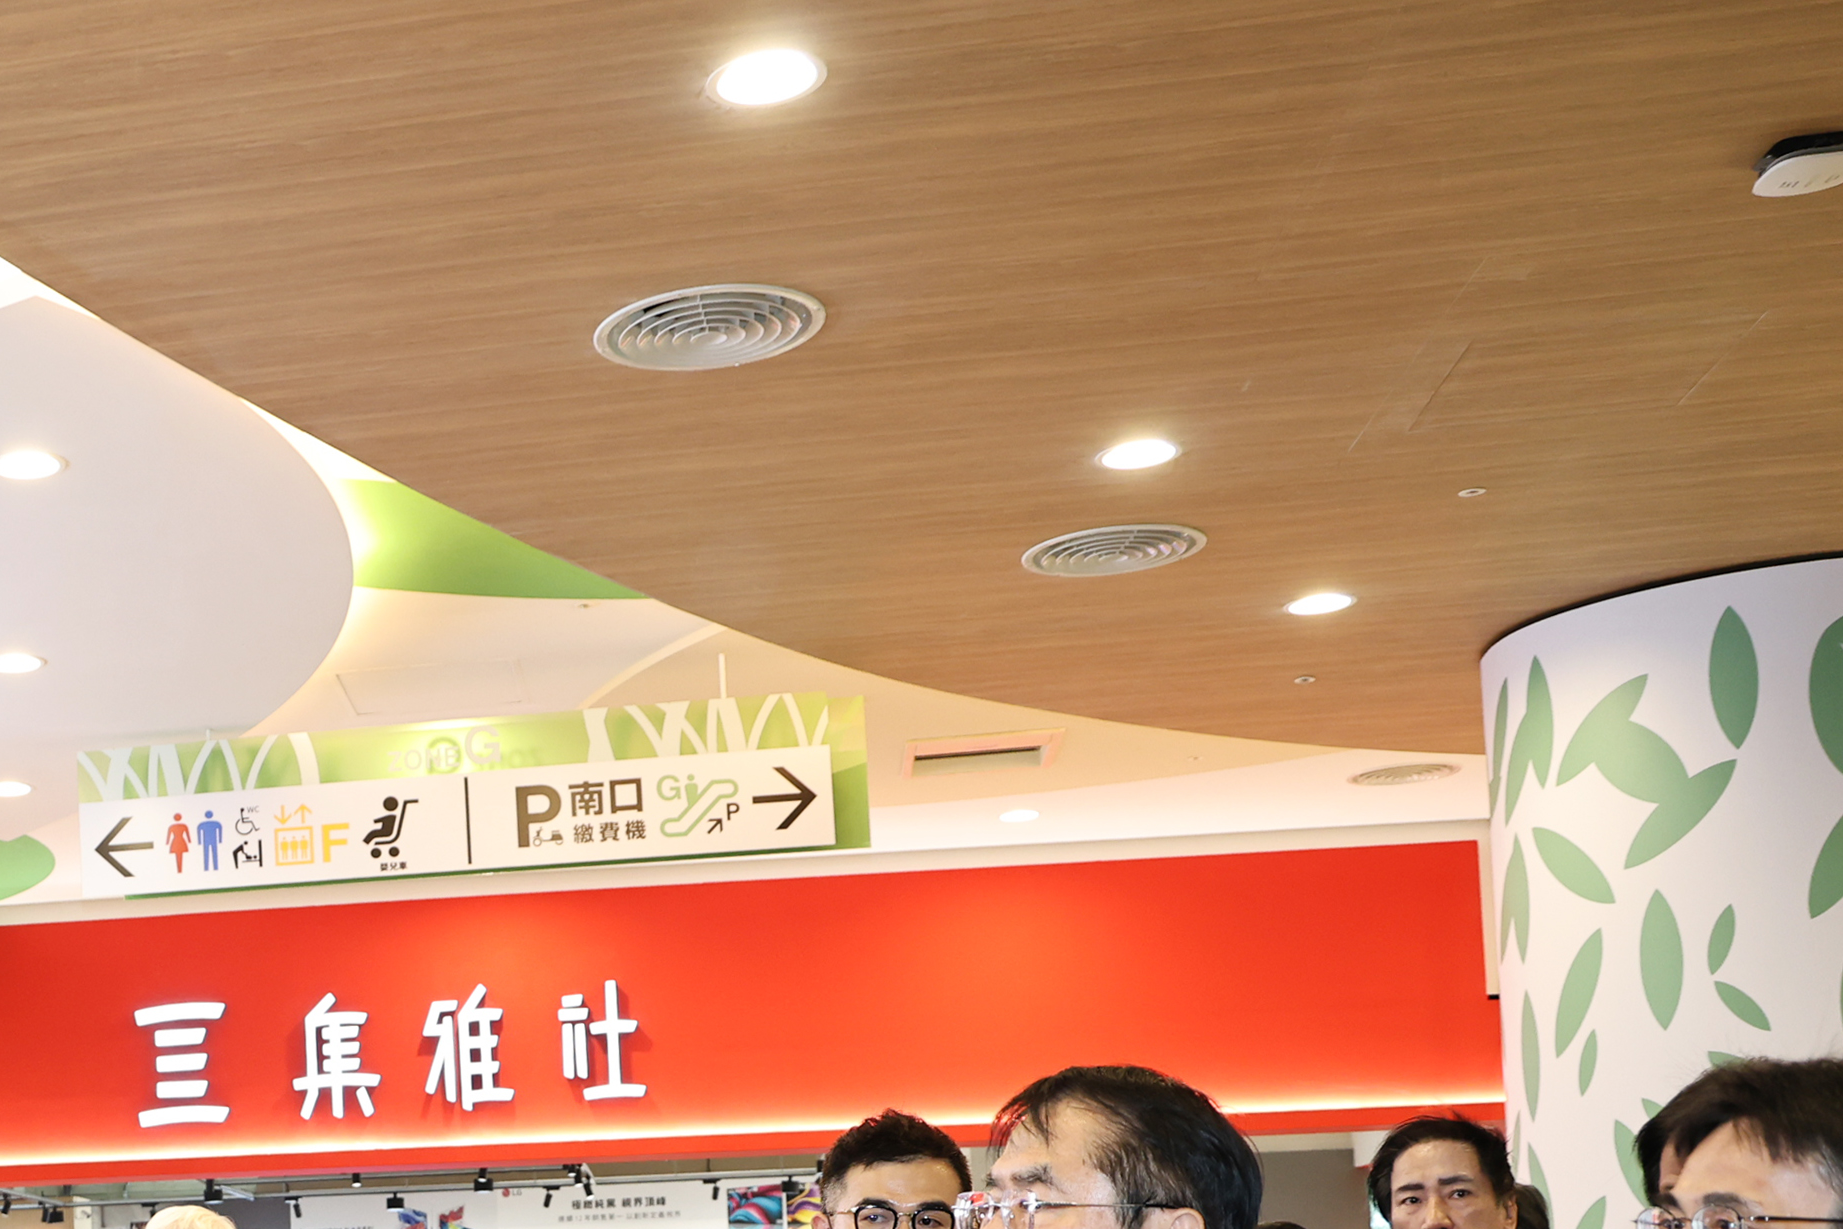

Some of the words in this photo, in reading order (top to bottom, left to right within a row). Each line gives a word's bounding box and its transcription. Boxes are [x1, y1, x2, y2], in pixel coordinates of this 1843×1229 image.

[388, 745, 461, 772] ZONE
[464, 725, 501, 765] G
[246, 806, 260, 814] WC
[515, 784, 562, 848] P
[568, 777, 644, 817] 南口
[726, 802, 741, 821] P
[321, 823, 350, 863] F
[573, 819, 647, 844] 繳費機
